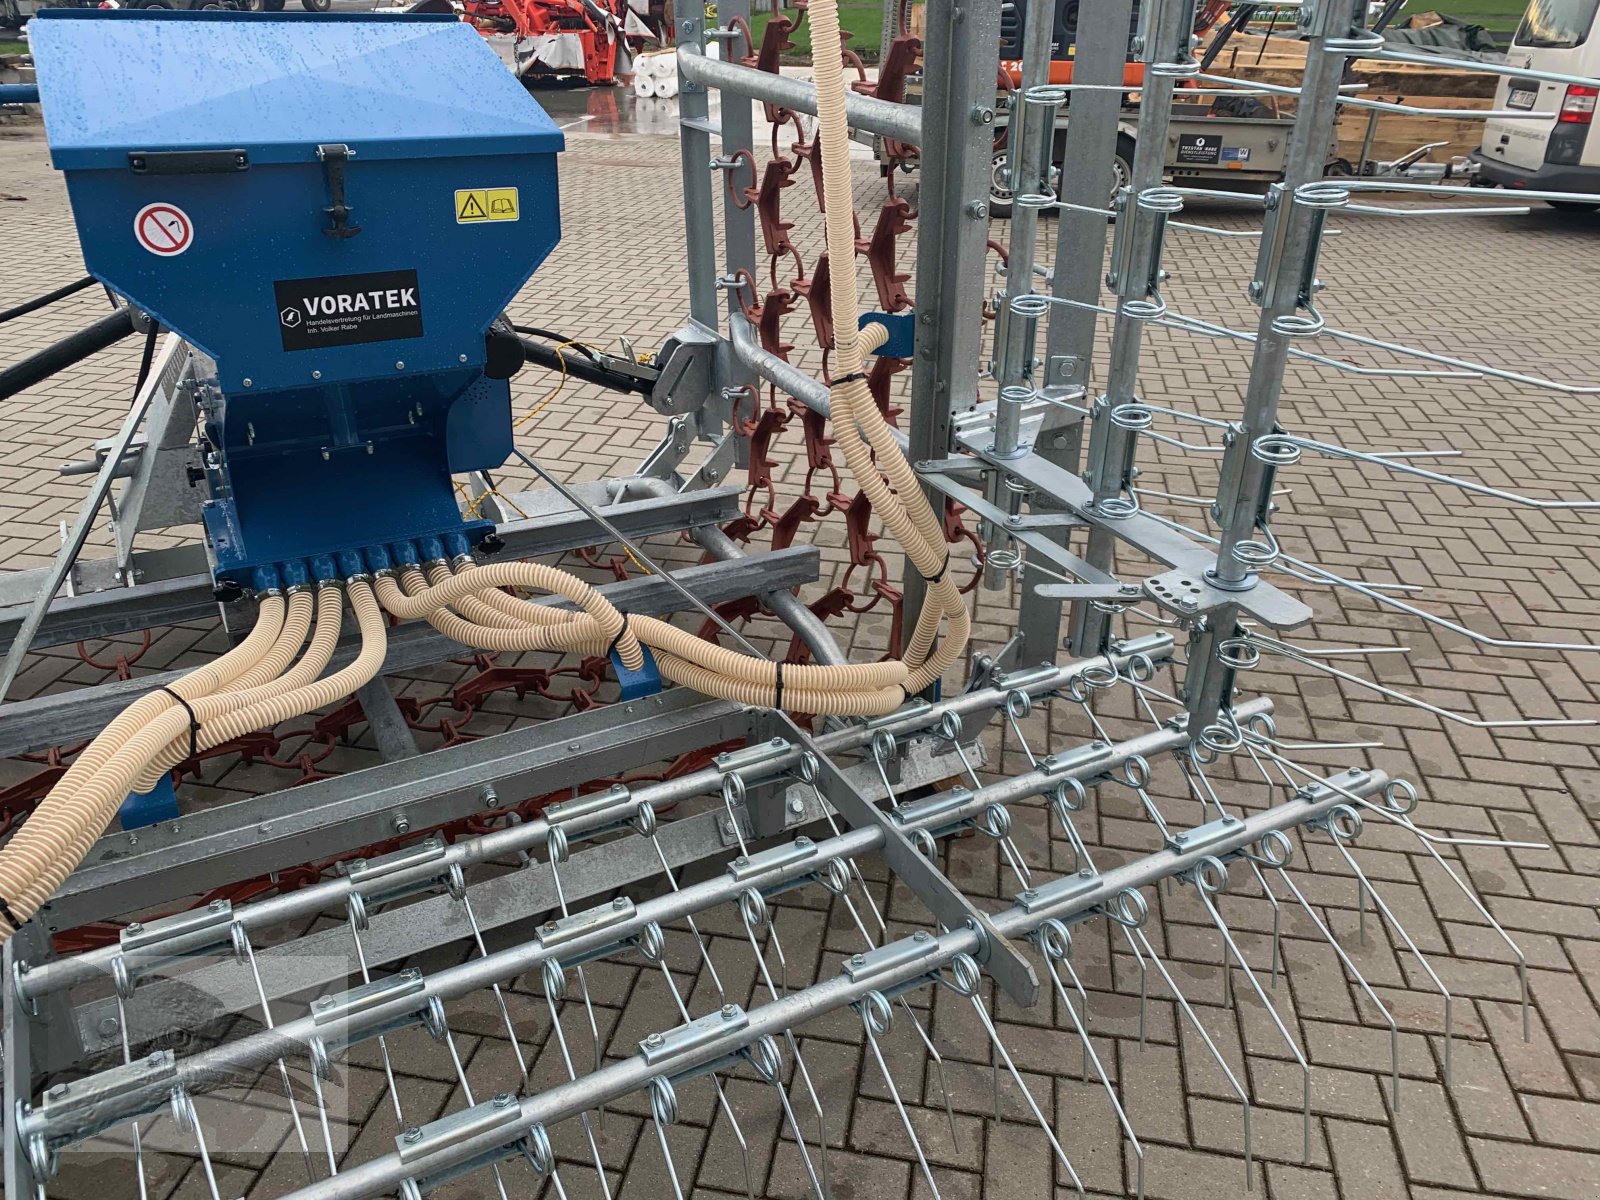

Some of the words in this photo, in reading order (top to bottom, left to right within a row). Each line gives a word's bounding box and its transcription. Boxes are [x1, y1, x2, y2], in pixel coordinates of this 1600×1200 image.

[303, 288, 417, 316] VORATEK
[306, 315, 361, 326] Handelsvertretung
[362, 313, 371, 321] für
[373, 310, 418, 320] Landmaschinen
[307, 326, 319, 334] Inh.
[320, 325, 340, 333] Volker
[341, 323, 358, 331] Rabe
